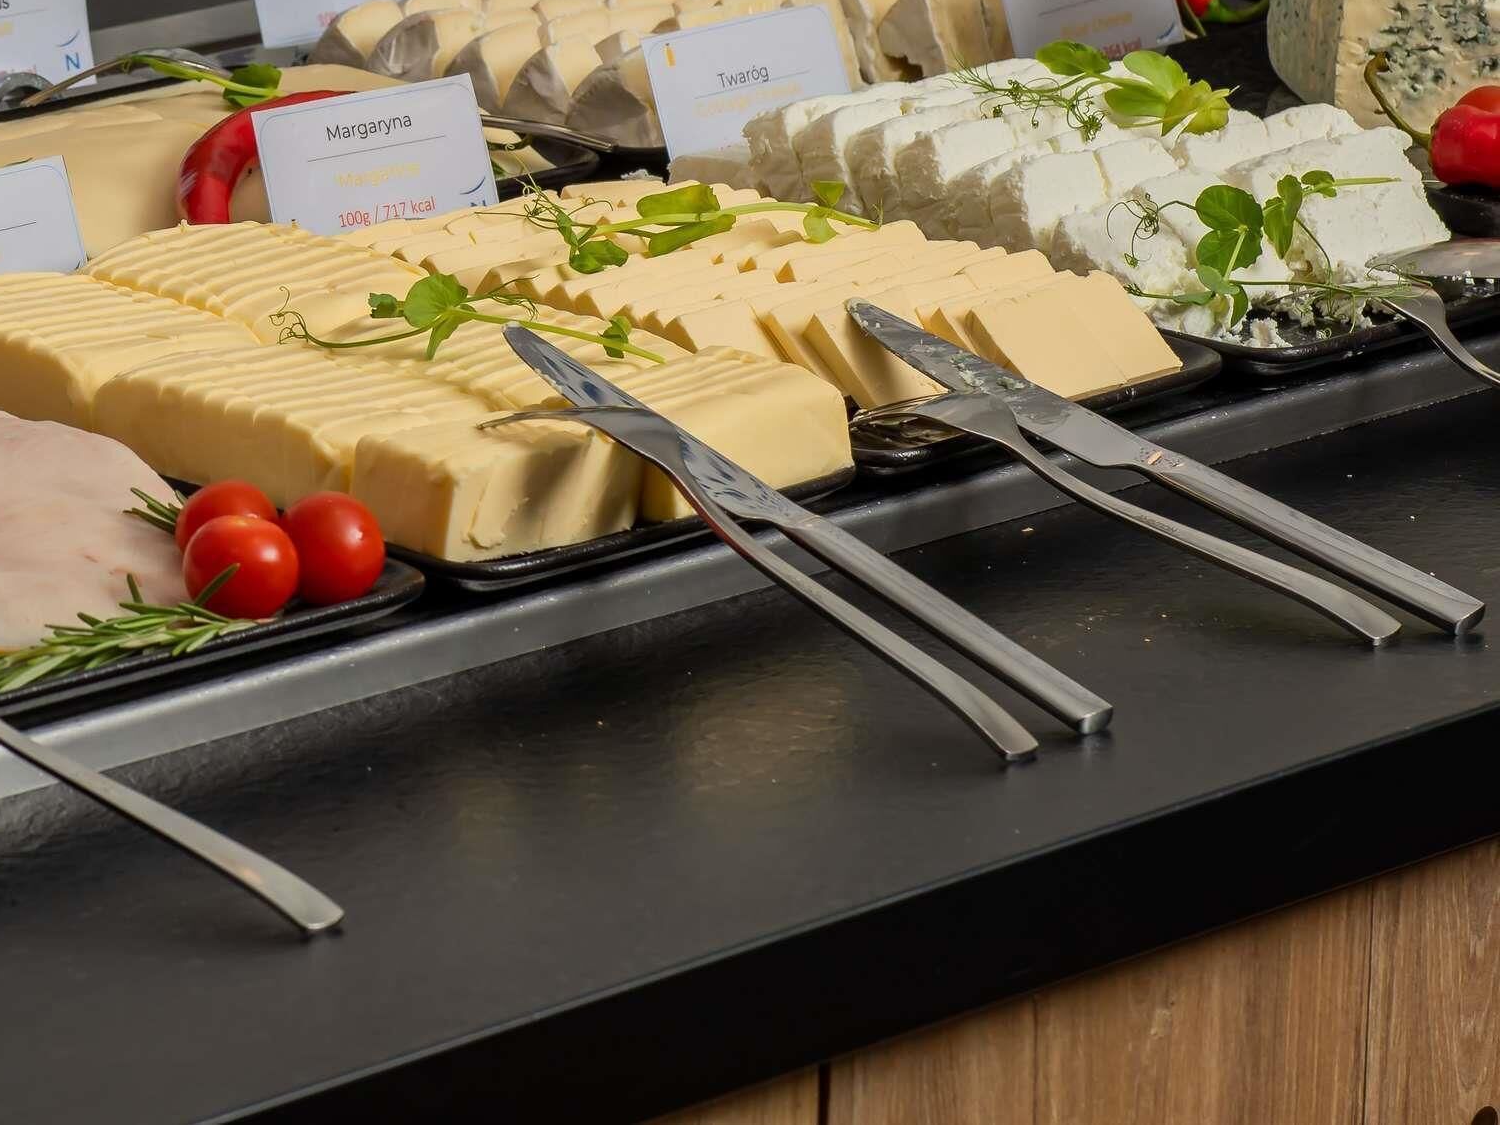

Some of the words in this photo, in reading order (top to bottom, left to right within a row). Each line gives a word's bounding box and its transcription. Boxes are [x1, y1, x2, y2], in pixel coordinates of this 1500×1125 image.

[64, 52, 81, 71] N
[717, 64, 770, 89] Twaróg
[325, 112, 412, 142] Margaryna
[338, 210, 372, 228] 100g
[382, 202, 407, 222] 717
[410, 195, 437, 215] kcal
